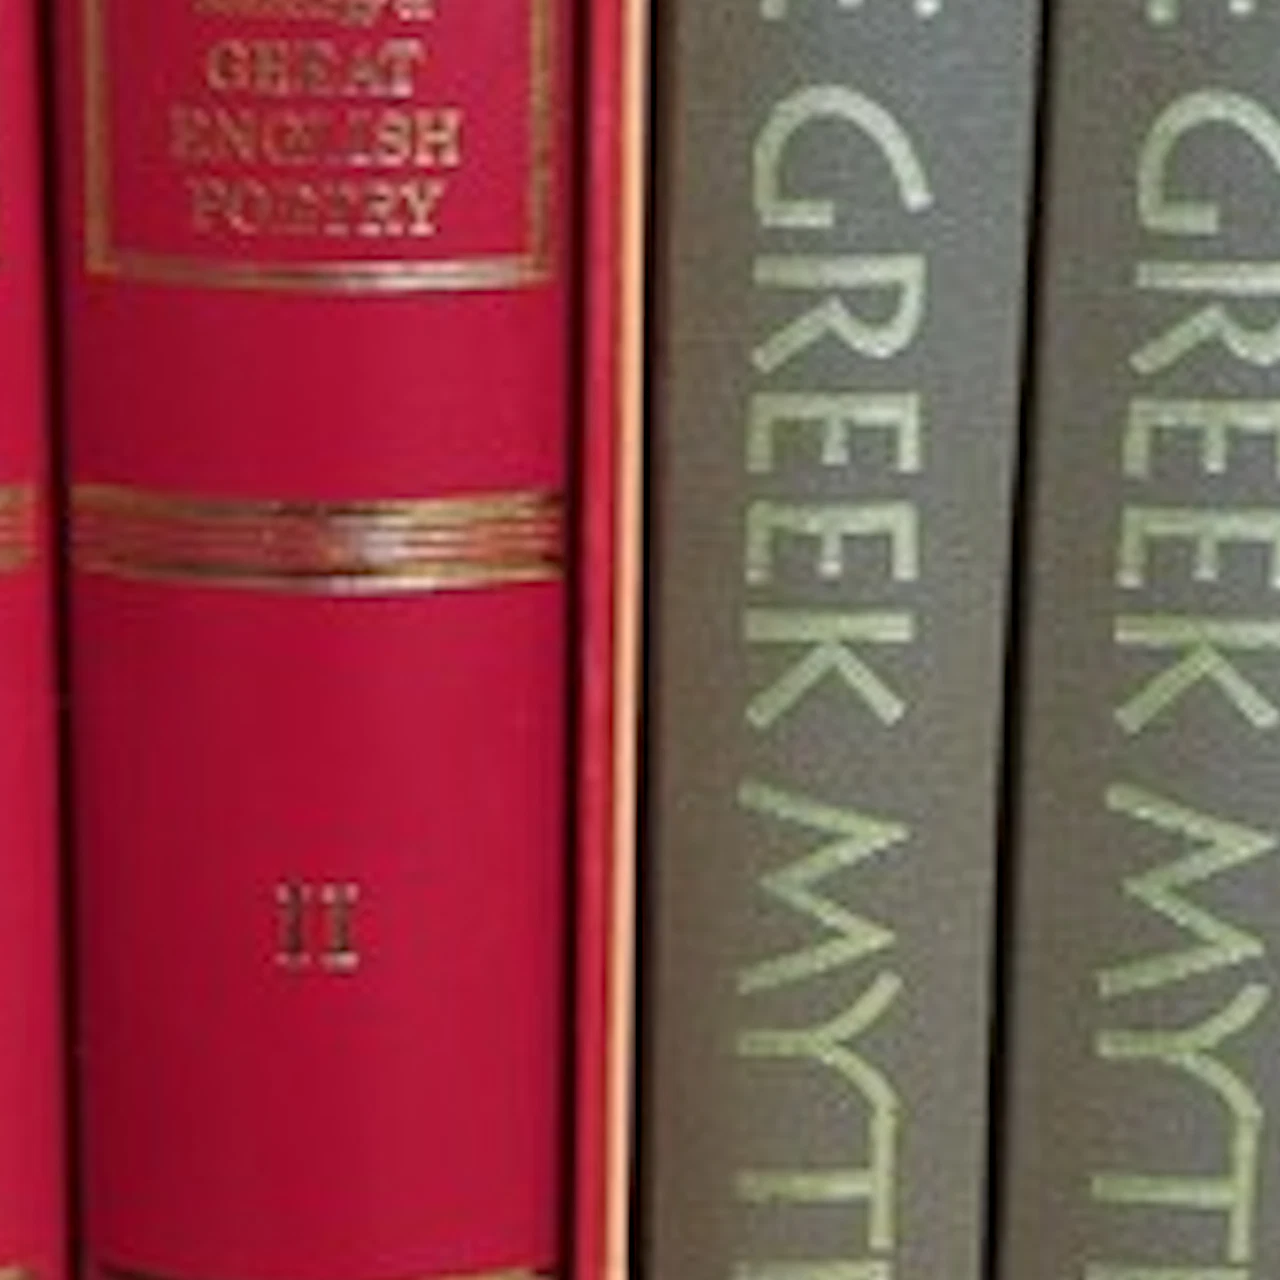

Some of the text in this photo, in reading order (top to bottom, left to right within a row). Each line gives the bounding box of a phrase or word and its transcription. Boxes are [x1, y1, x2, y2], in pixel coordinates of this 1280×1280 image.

[206, 38, 424, 97] GREAT
[170, 106, 463, 168] ENGISH
[745, 84, 934, 727] GREEK
[275, 882, 358, 970] II
